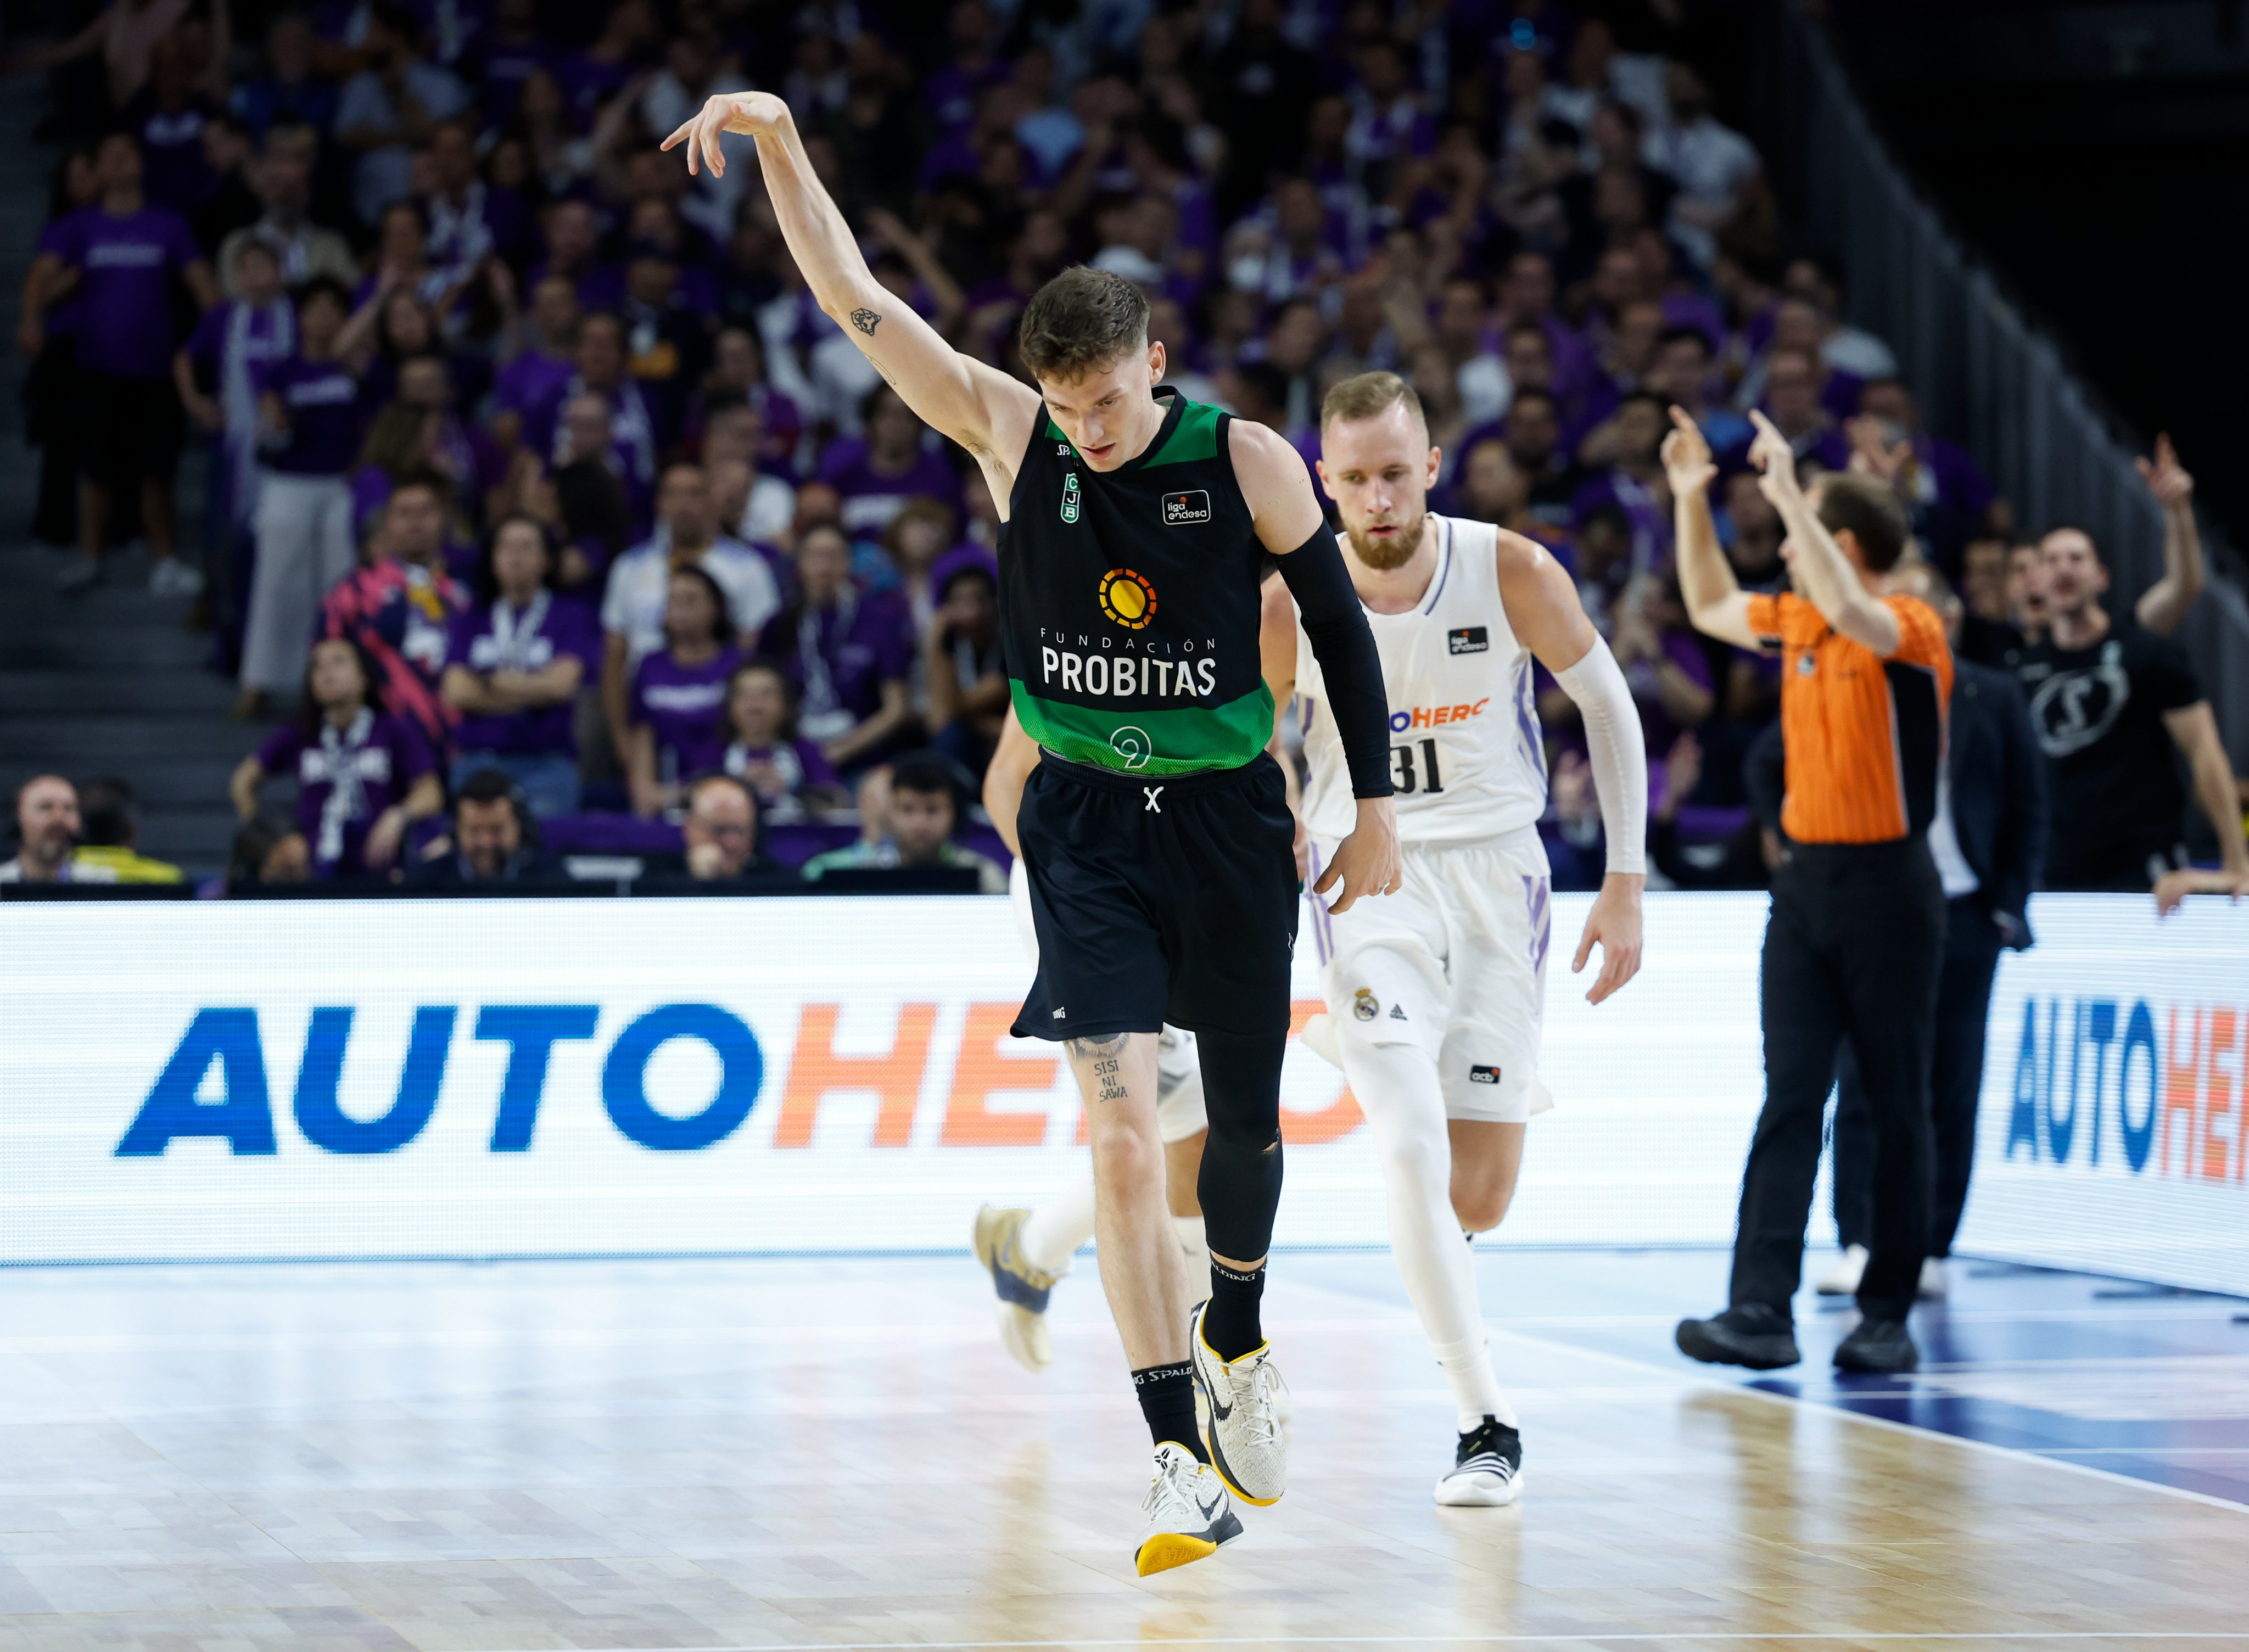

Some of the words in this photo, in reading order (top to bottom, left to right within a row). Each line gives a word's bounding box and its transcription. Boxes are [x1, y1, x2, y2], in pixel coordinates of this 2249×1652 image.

[1167, 502, 1185, 512] liga
[1168, 509, 1207, 520] endesa
[1040, 628, 1215, 653] FUNDACIÓN
[1042, 646, 1216, 697] PROBITAS
[1110, 726, 1152, 769] 9
[1390, 738, 1444, 794] 31
[1094, 1060, 1120, 1076] SISI
[1102, 1076, 1116, 1088] NI
[1472, 1072, 1494, 1083] acb
[1099, 1087, 1128, 1102] SAWA
[2003, 995, 2249, 1186] AUTOHE
